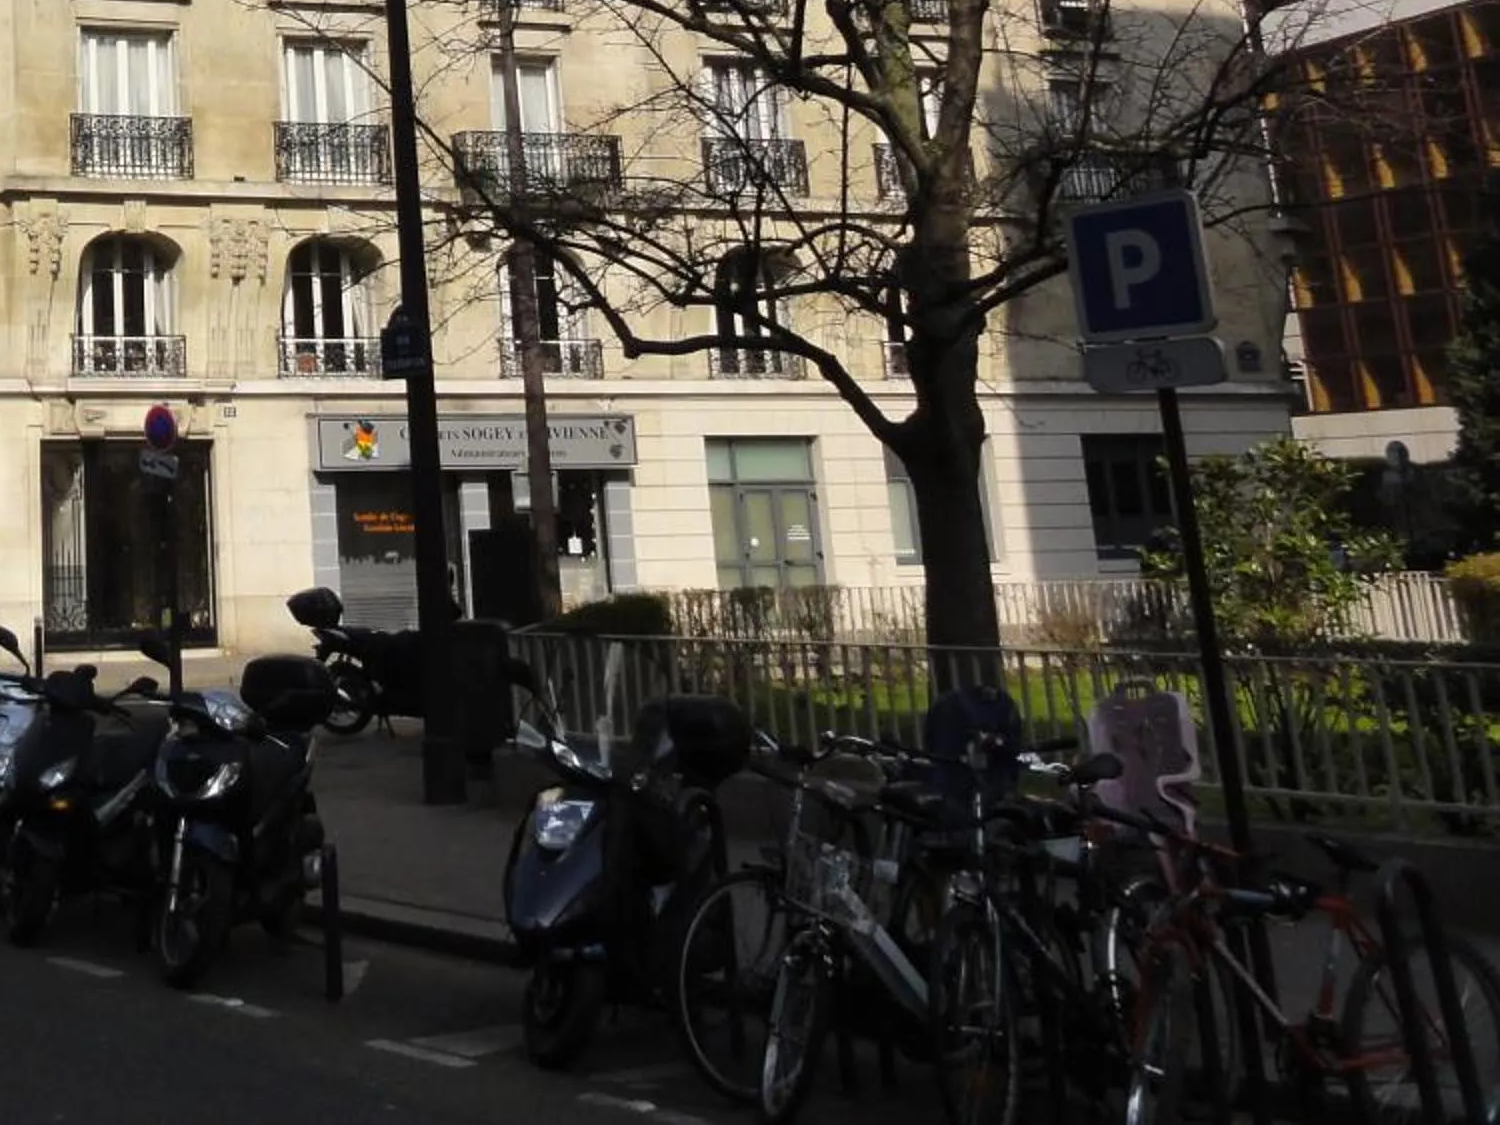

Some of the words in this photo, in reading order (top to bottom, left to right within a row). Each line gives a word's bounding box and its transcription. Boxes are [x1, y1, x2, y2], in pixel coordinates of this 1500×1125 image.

[1105, 229, 1162, 310] P
[462, 426, 513, 441] SOGEY
[546, 426, 609, 440] IVIENNE
